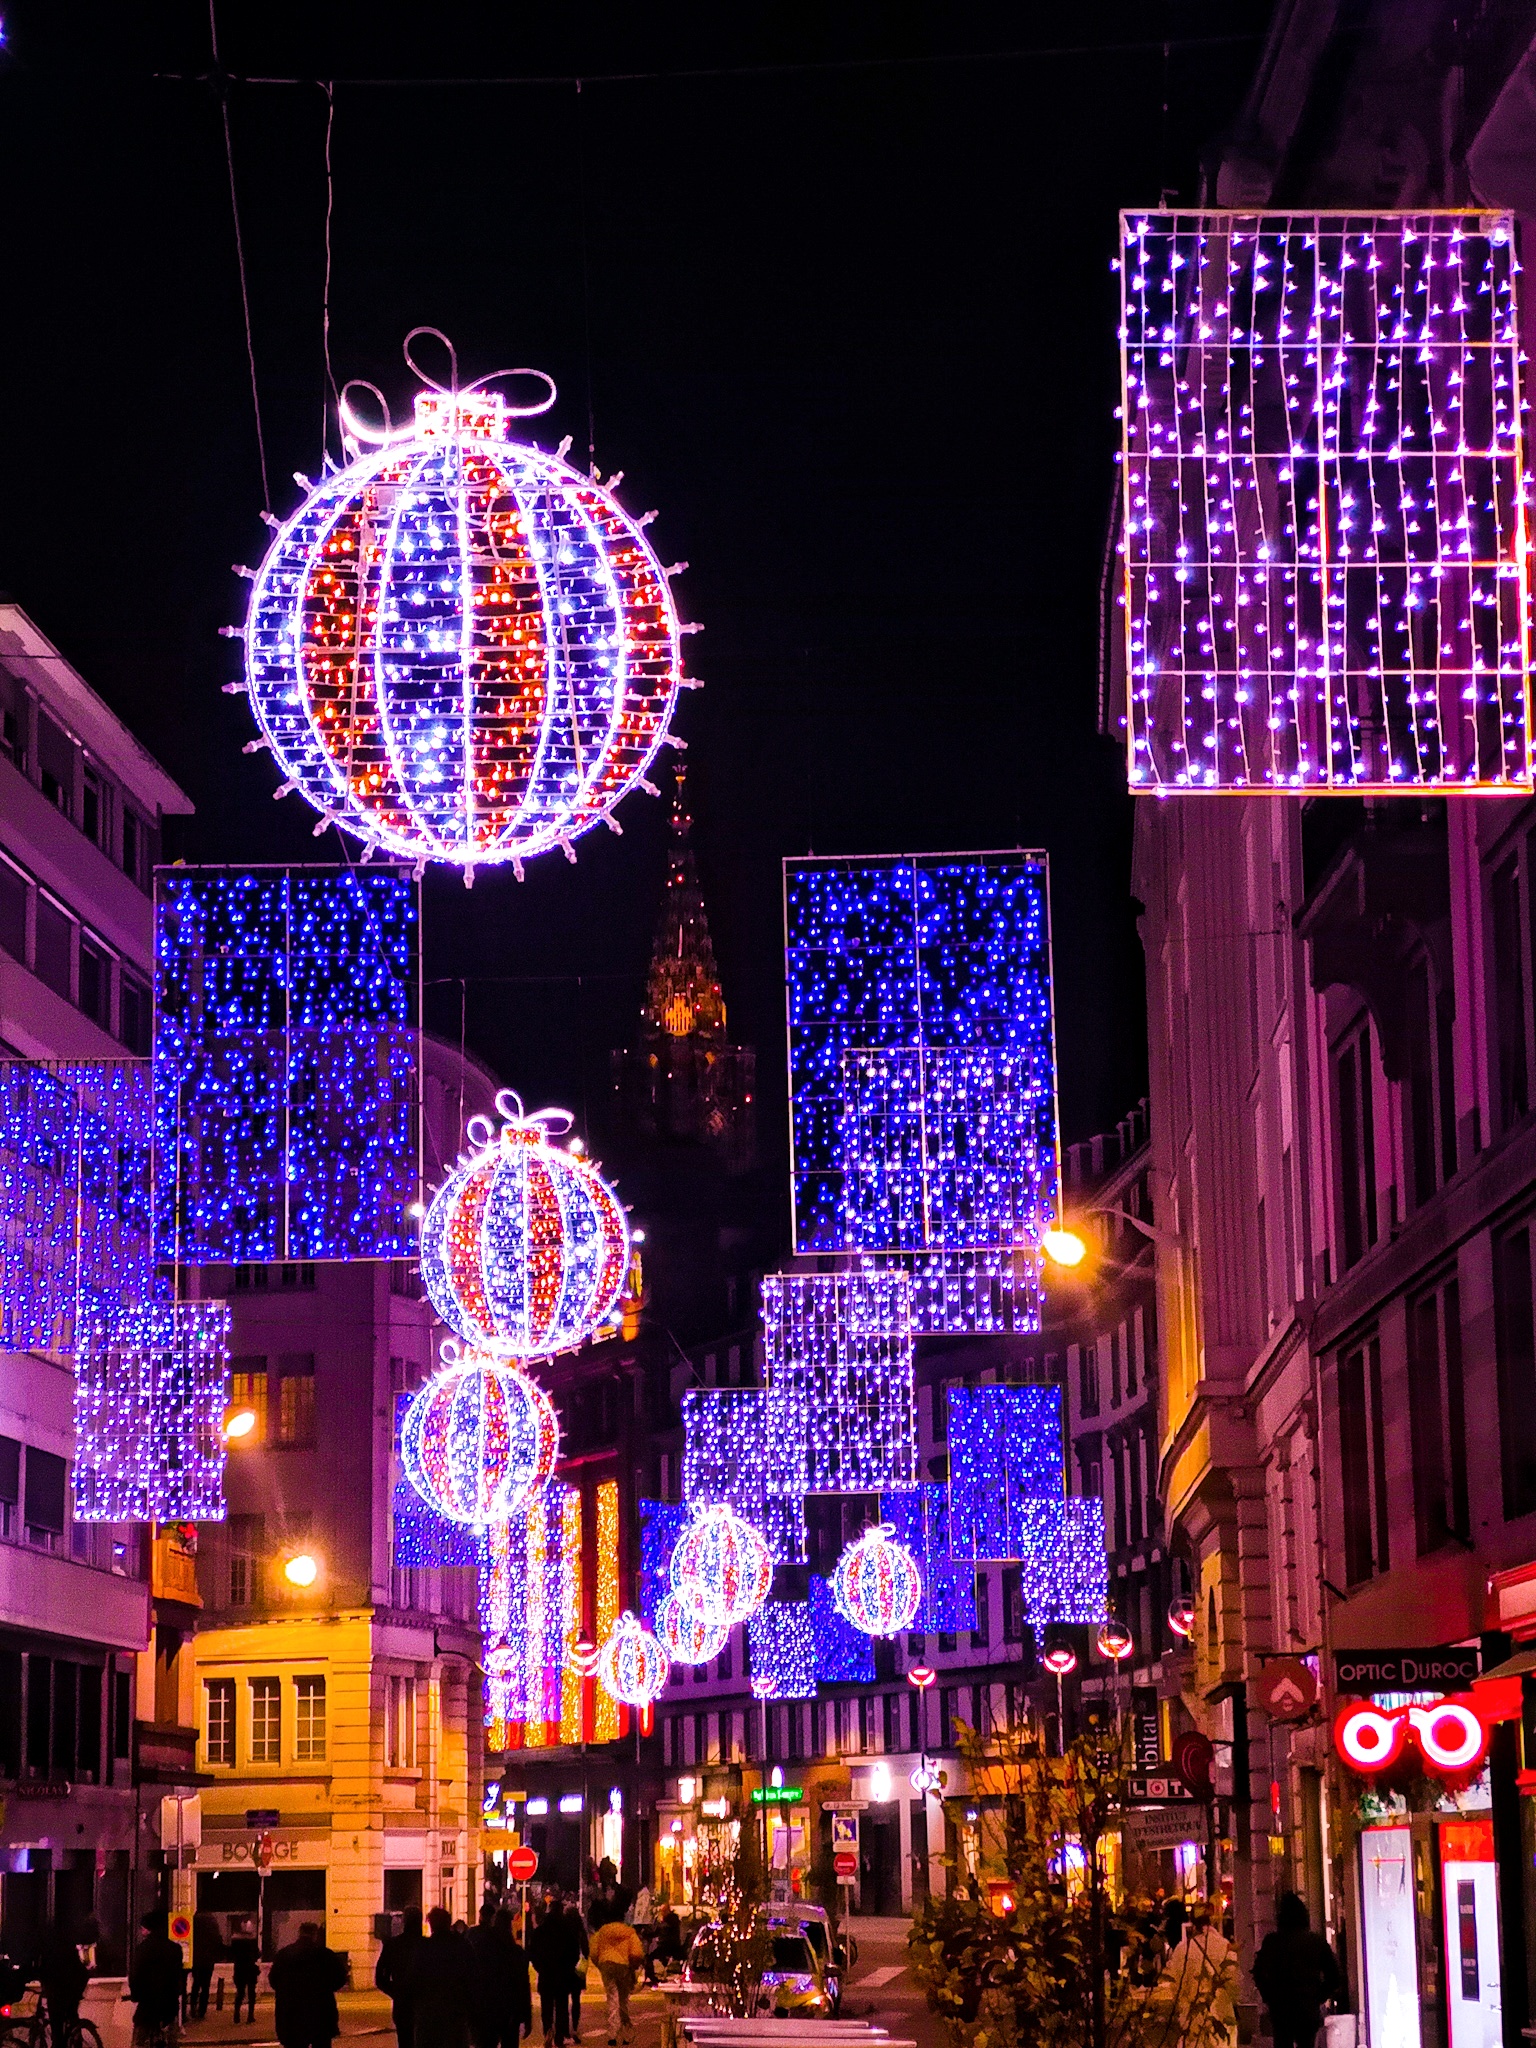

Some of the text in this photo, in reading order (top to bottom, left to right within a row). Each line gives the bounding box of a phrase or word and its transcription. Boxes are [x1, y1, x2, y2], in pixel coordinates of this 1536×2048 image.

[1340, 1659, 1474, 1684] OPTIC DUROC
[222, 1840, 298, 1861] BOGE
